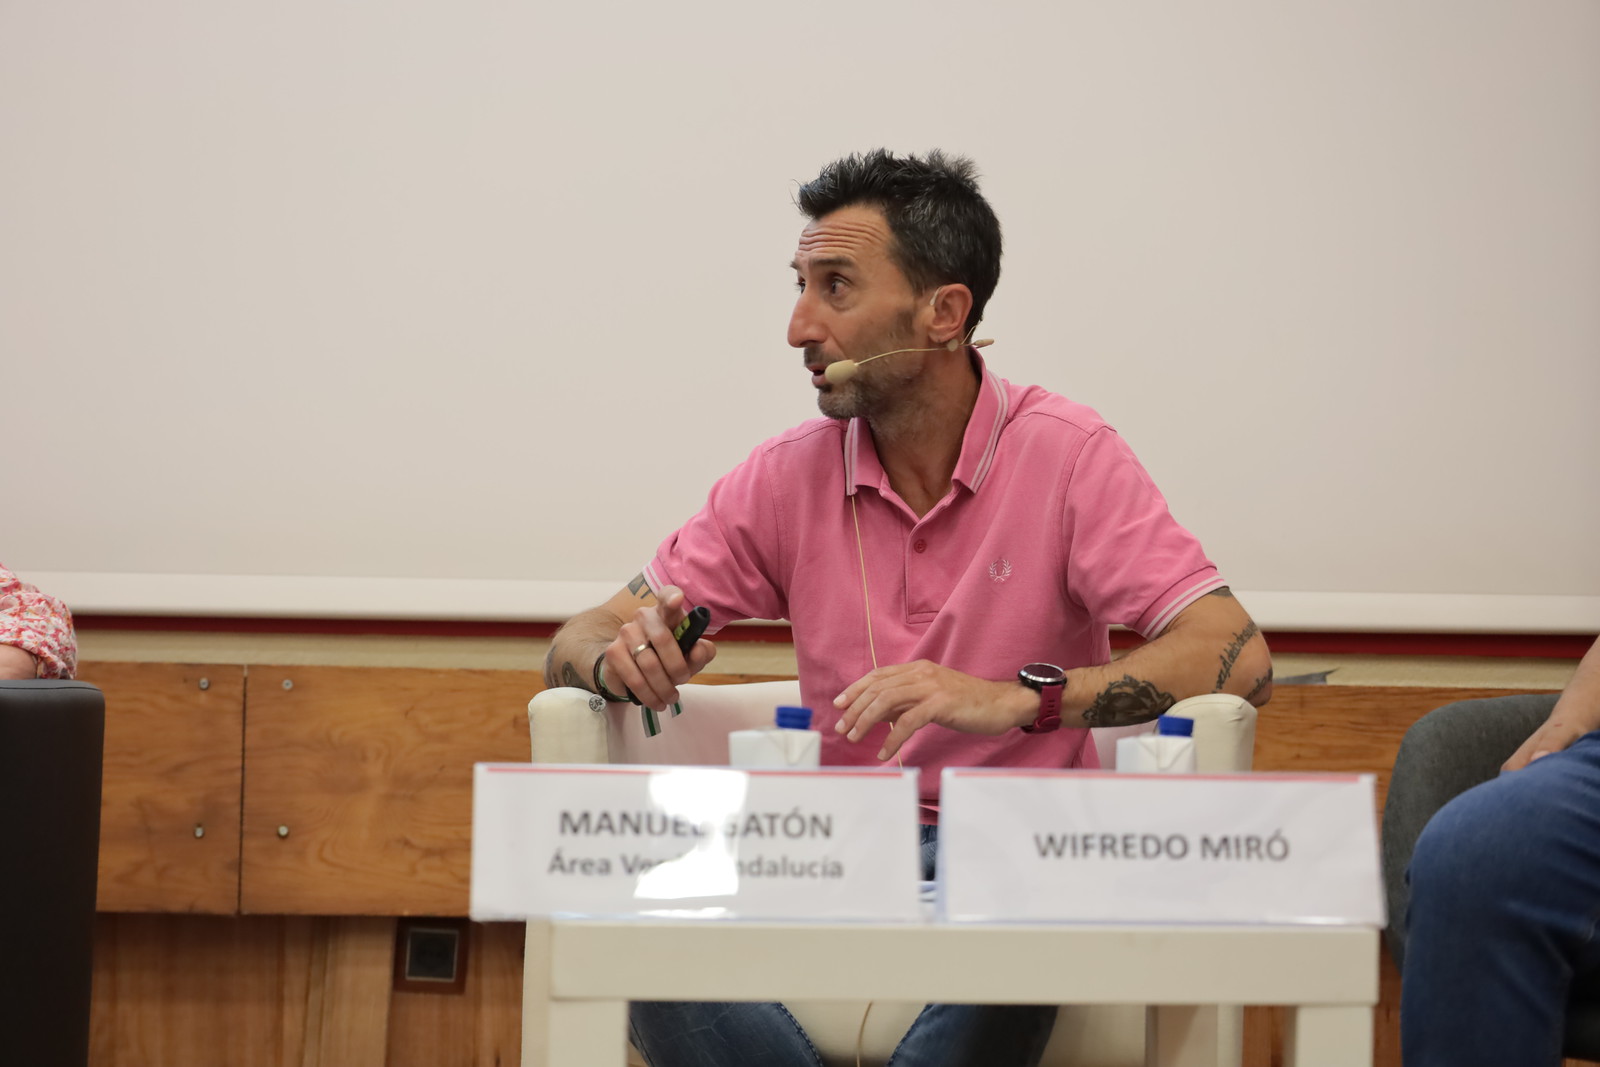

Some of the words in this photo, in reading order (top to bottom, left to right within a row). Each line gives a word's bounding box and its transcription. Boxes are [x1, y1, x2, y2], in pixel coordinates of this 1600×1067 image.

[722, 807, 832, 839] ATÓN
[1034, 833, 1190, 860] WIFREDO
[1200, 829, 1290, 862] MIRÓ
[548, 850, 612, 875] Área
[732, 856, 843, 877] ndalucía
